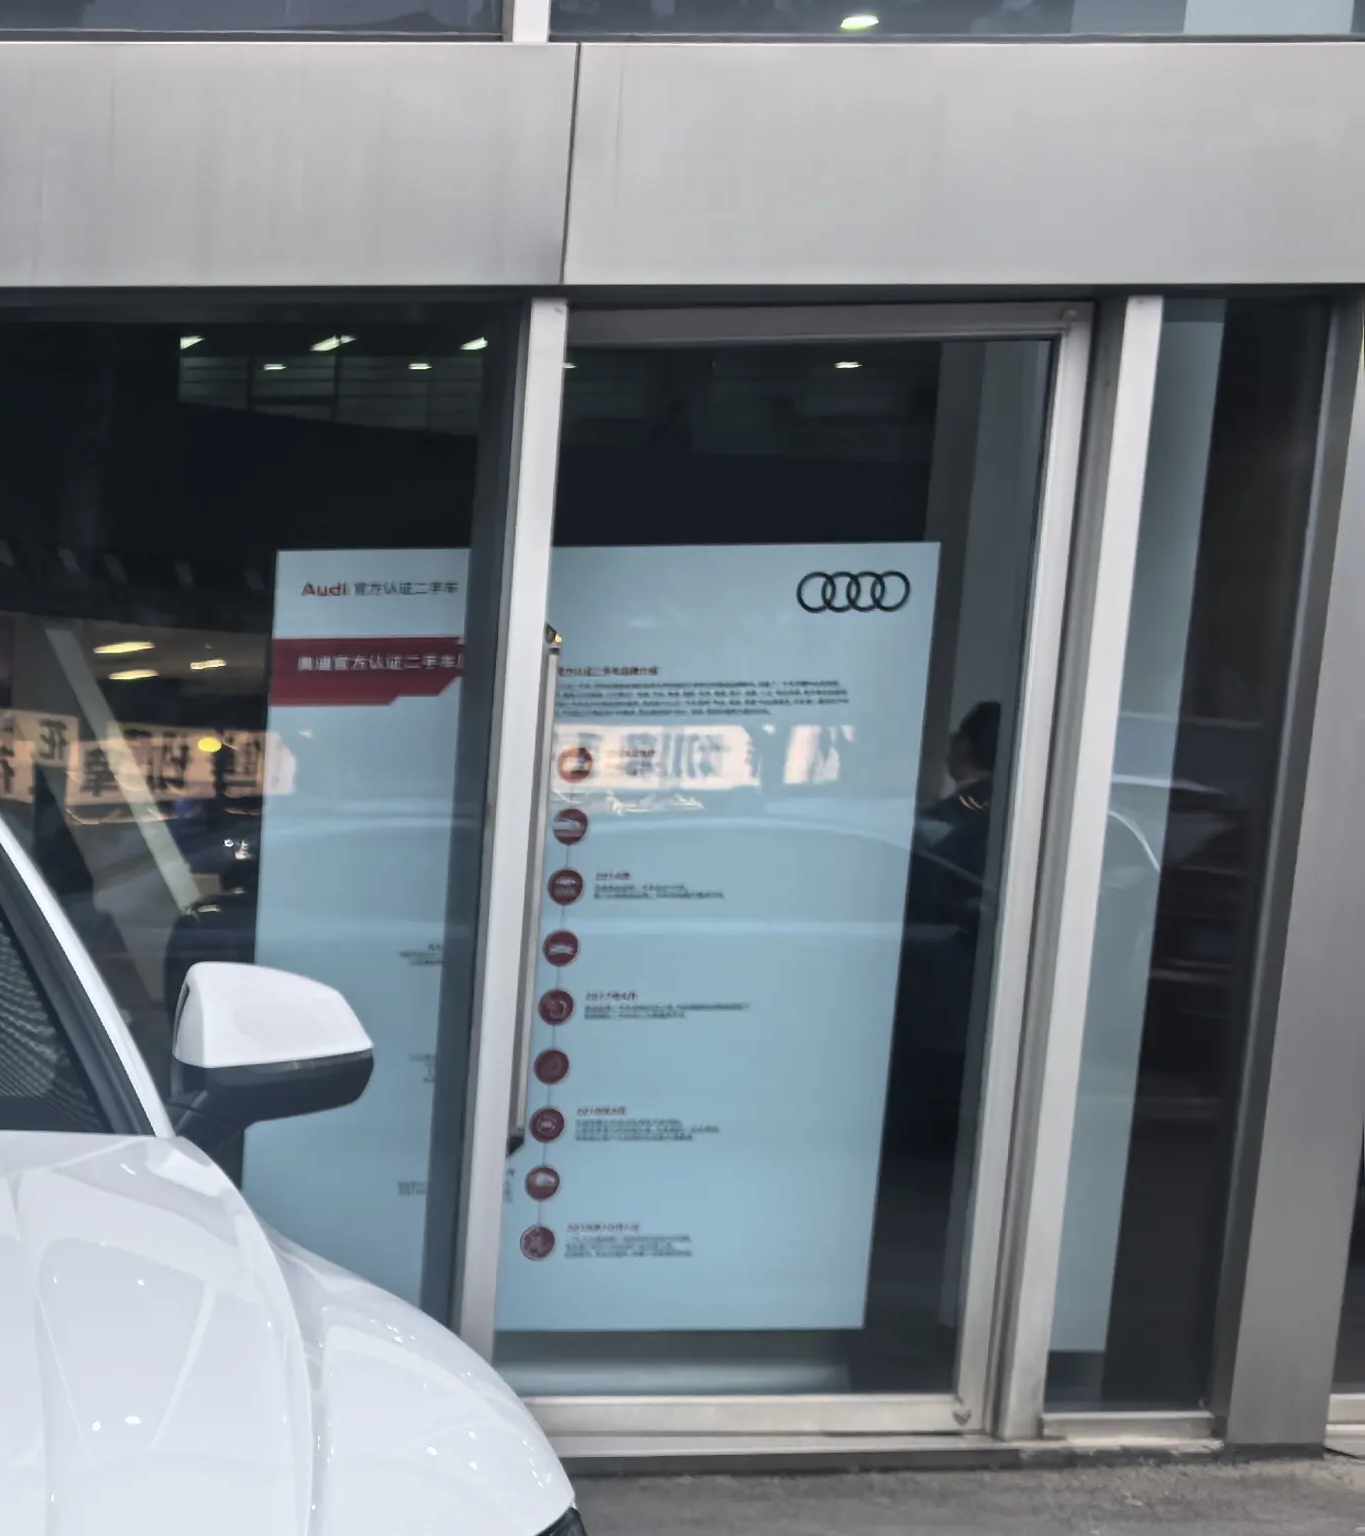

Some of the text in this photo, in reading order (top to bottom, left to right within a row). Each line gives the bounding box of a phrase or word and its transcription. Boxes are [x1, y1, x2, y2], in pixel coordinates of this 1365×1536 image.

[301, 581, 459, 597] Audi 官方认证二手车
